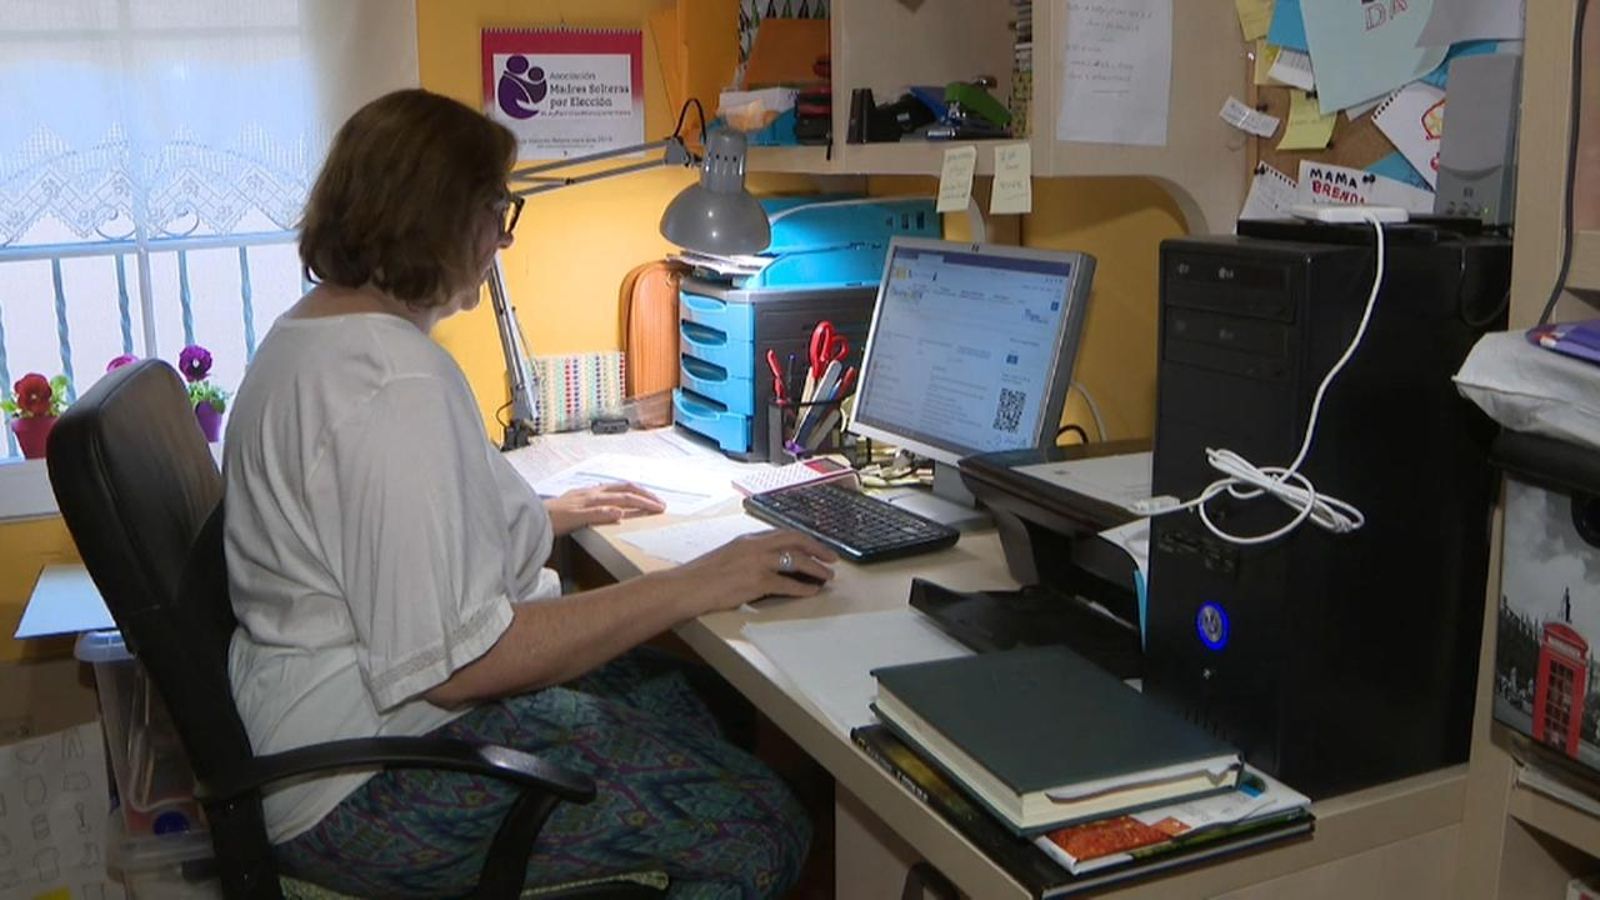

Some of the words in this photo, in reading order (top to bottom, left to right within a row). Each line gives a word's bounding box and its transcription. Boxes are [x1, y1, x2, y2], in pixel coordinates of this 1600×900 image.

[550, 72, 596, 80] Asociación
[550, 83, 587, 94] Madres
[589, 83, 629, 94] Solteras
[550, 98, 568, 110] por
[570, 97, 613, 107] Elección
[1309, 168, 1358, 189] MAMA
